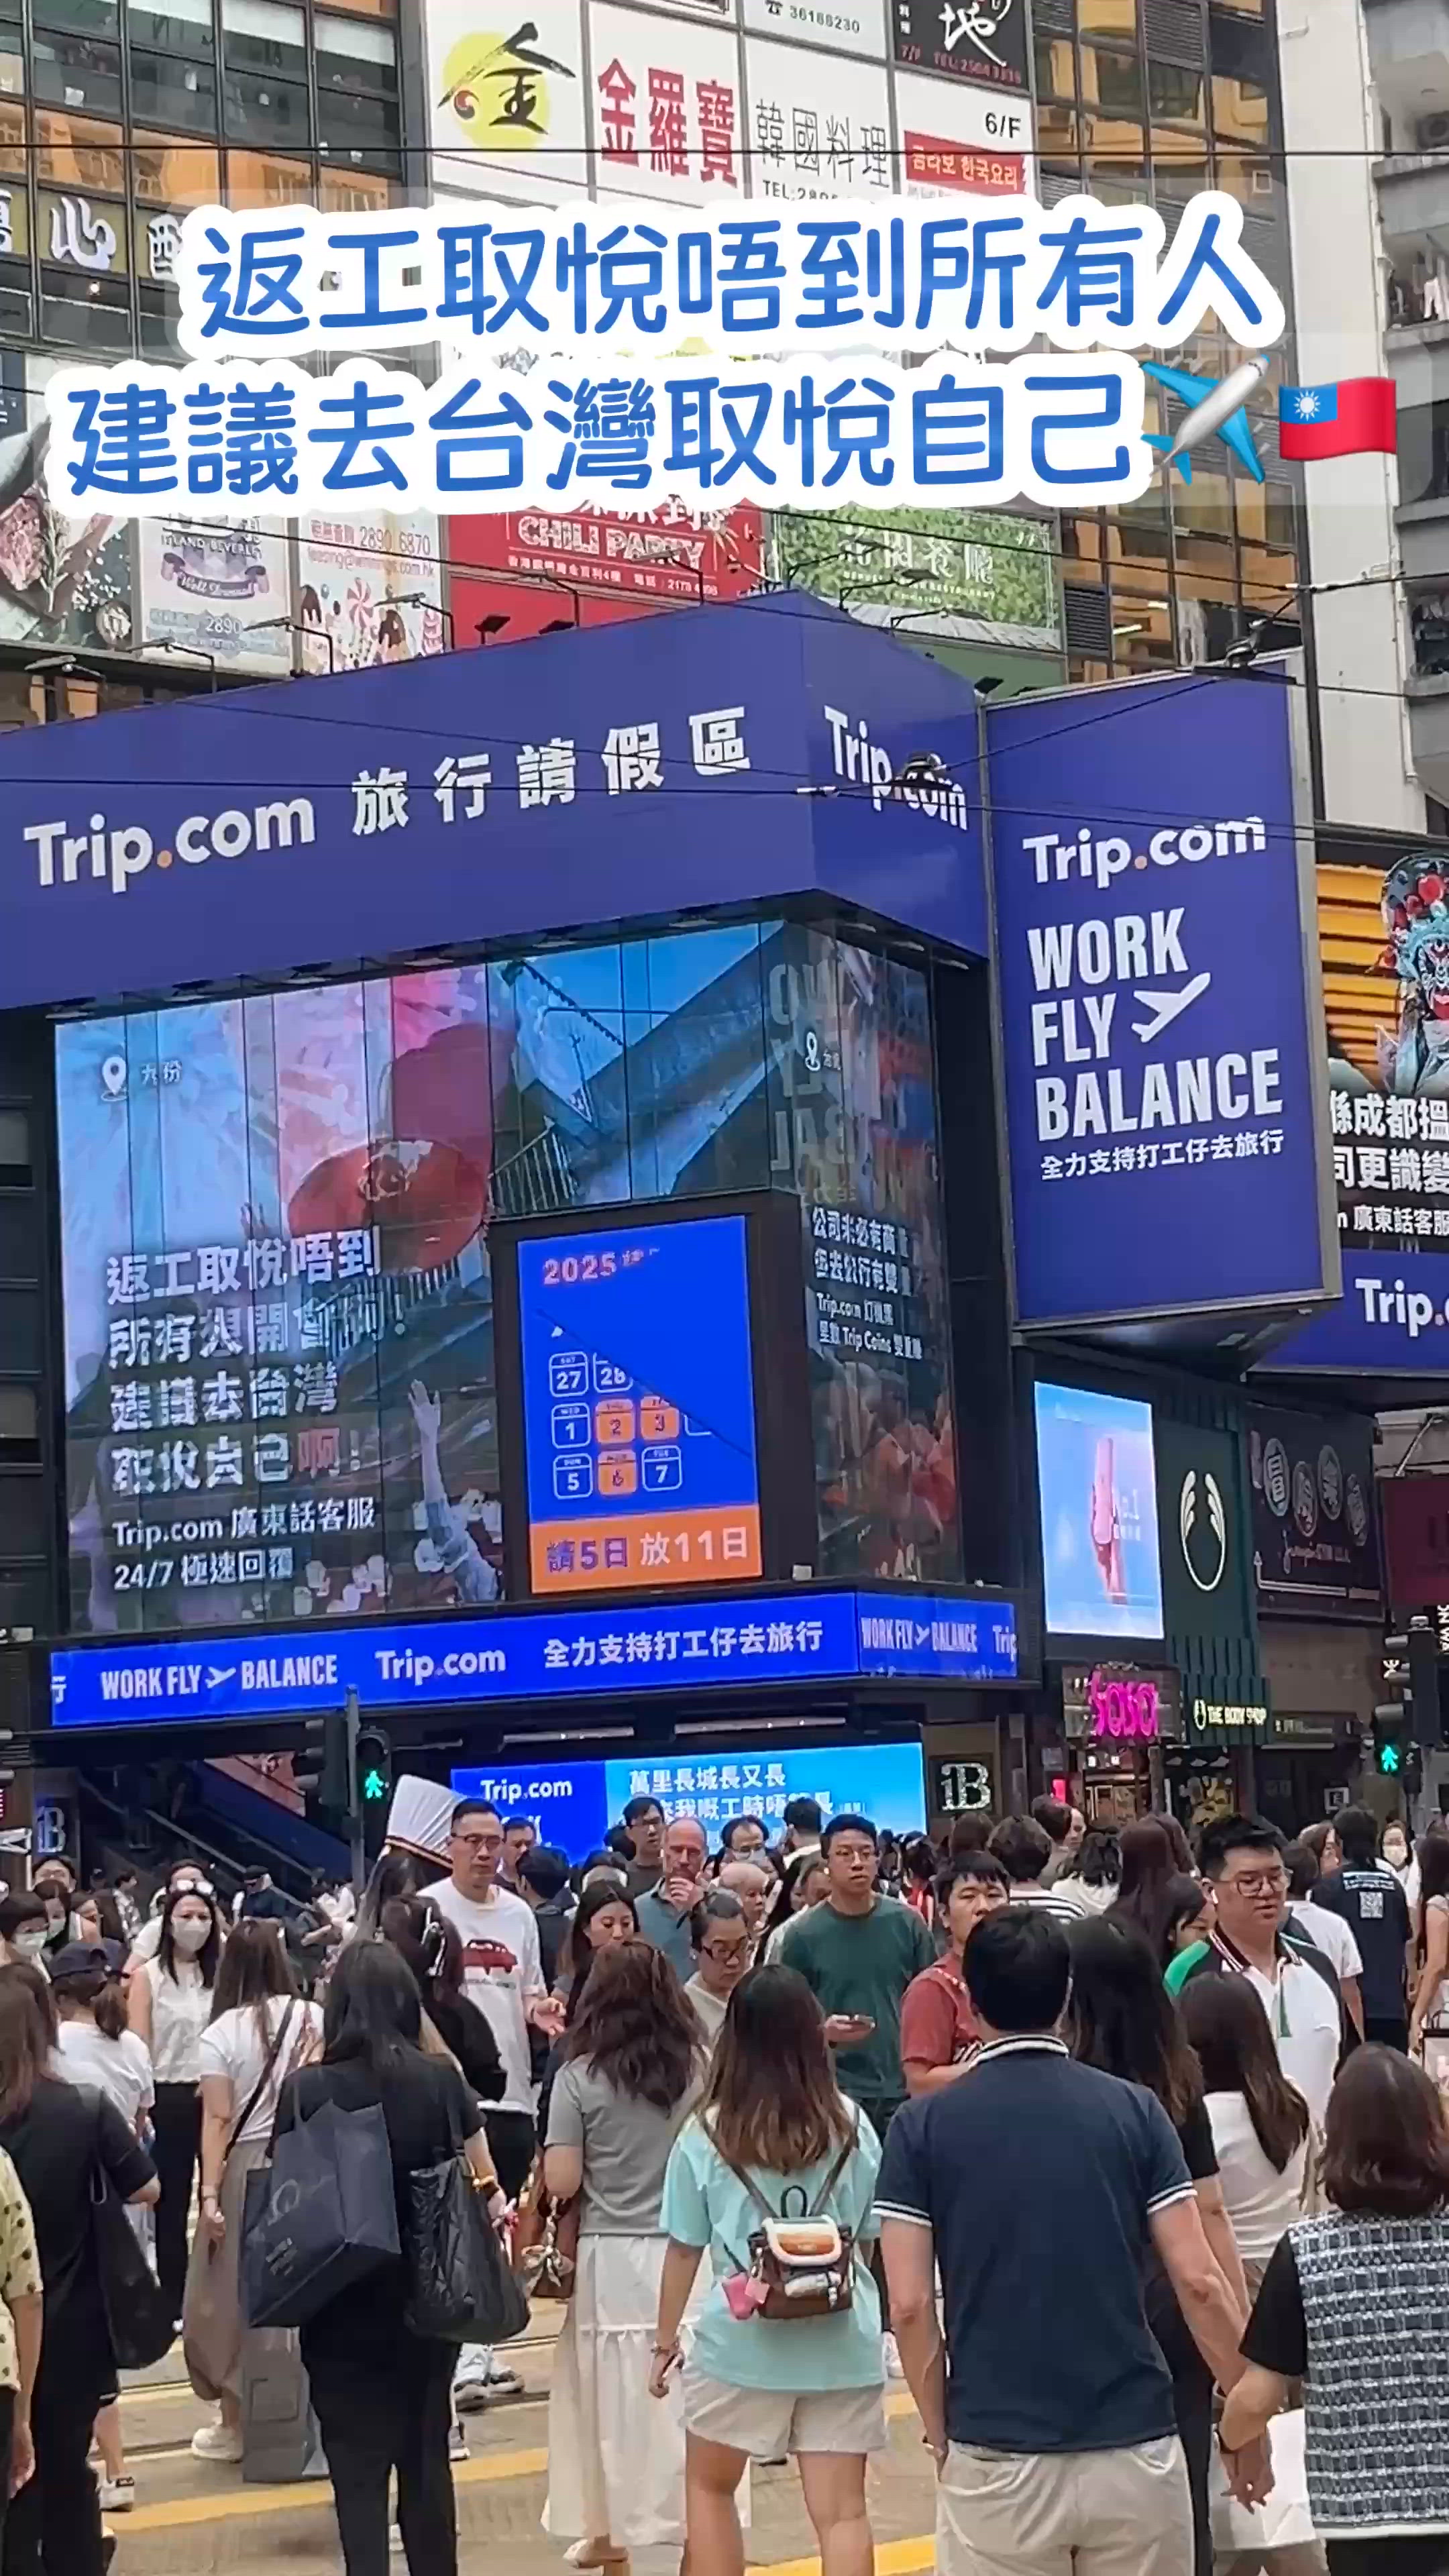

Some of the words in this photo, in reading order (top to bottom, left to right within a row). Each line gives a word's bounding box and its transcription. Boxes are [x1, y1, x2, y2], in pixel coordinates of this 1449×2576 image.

[598, 58, 737, 188] 金羅寶
[756, 99, 890, 189] 韓國料理
[985, 112, 1022, 139] 6/F
[398, 531, 431, 555] 6870
[518, 515, 600, 555] CHILI
[606, 527, 705, 570] PARTY
[23, 798, 315, 894] Trip.com
[351, 706, 751, 836] 旅行請假區
[1022, 815, 1267, 889] Trip.com
[1027, 907, 1189, 991] WORK
[1032, 993, 1117, 1067] FLY
[1035, 1048, 1284, 1142] BALANCE
[1040, 1130, 1284, 1181] 全力支持打工仔去旅行
[107, 1226, 380, 1305] 返工取悅唔到
[543, 1250, 617, 1285] 2025
[556, 1370, 582, 1391] 27
[565, 1421, 576, 1441] 1
[567, 1472, 580, 1491] 5
[655, 1464, 669, 1484] 7
[112, 1519, 223, 1552] Trip.com
[231, 1497, 376, 1539] 廣東話客服
[639, 1525, 748, 1566] 放11日
[114, 1561, 174, 1590] 24/7
[101, 1667, 162, 1700] WORK
[168, 1664, 203, 1696] FLY
[241, 1654, 339, 1690] BALANCE
[375, 1648, 506, 1686] Trip.com
[543, 1621, 823, 1668] 全力支持打工仔去旅行
[480, 1778, 574, 1805] Trip.com
